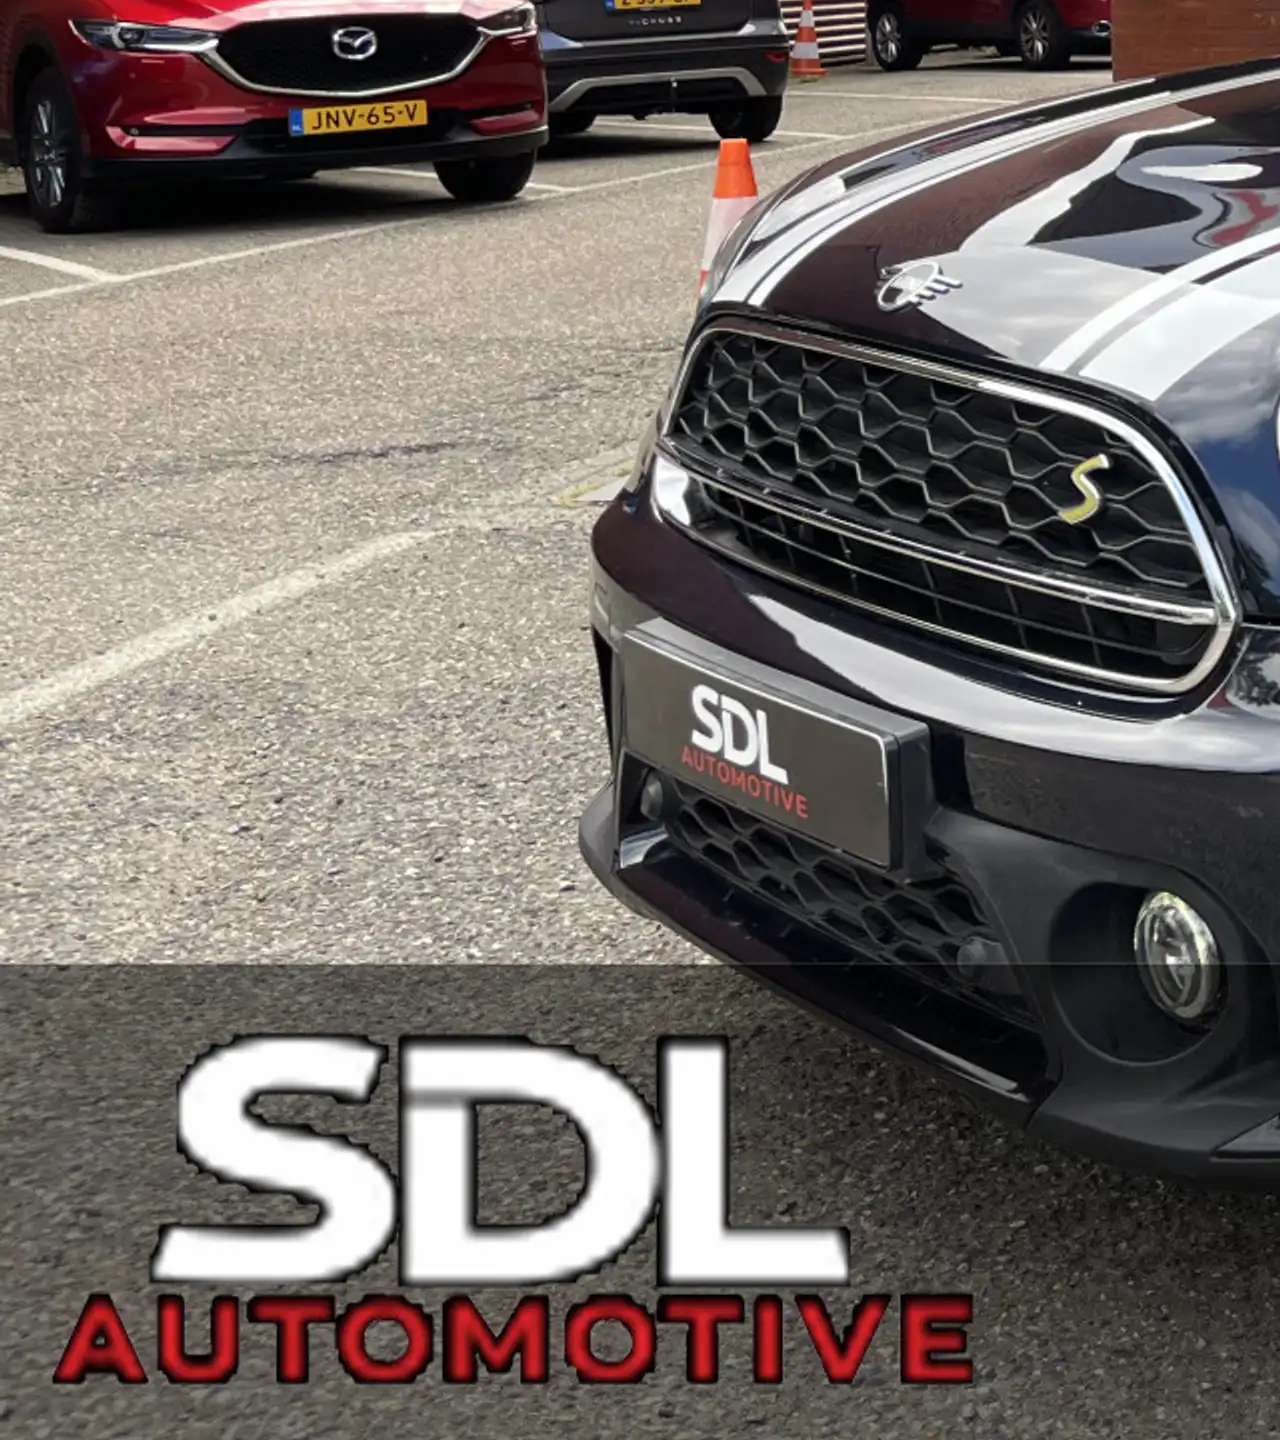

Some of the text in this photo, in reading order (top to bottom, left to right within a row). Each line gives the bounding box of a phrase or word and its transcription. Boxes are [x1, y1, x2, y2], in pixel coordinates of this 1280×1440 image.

[312, 103, 418, 131] JNV-65-V
[691, 684, 789, 785] SDL
[681, 744, 809, 818] AUTOMOTIVE
